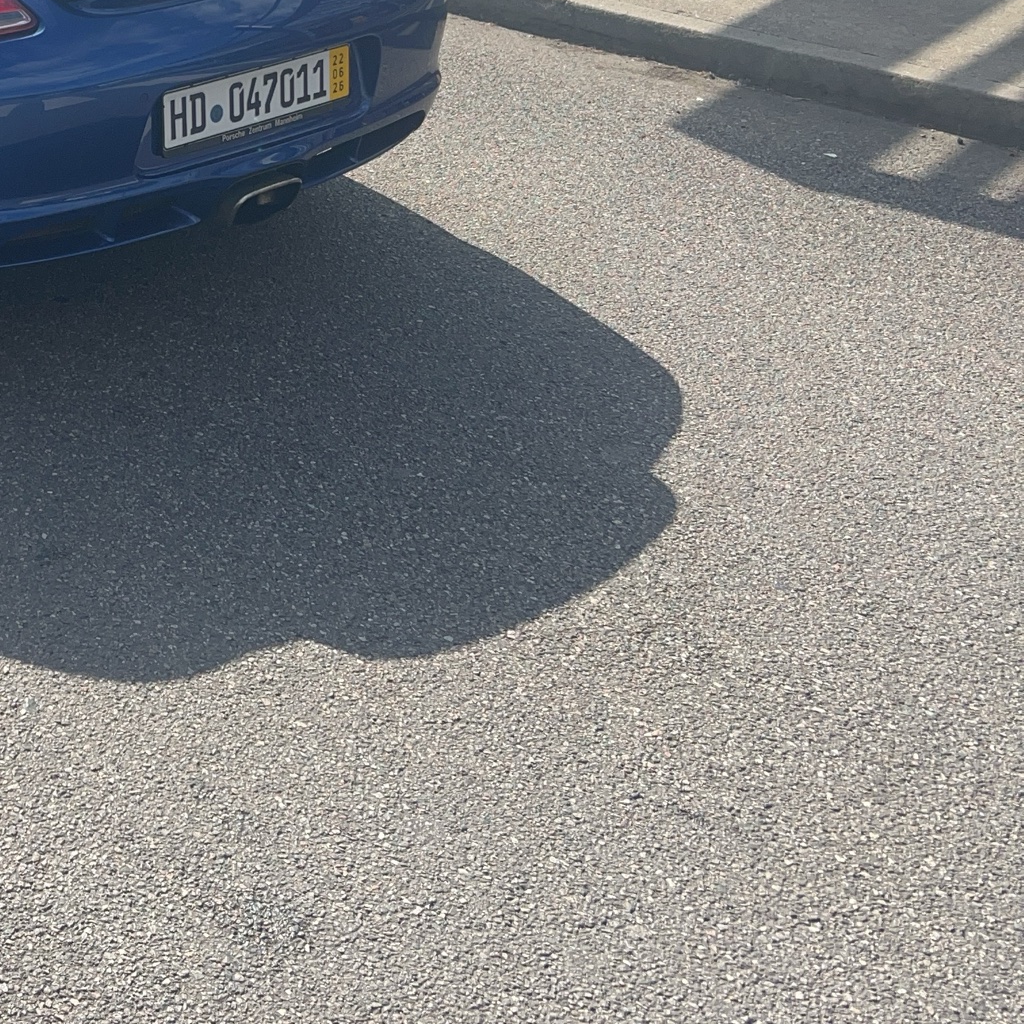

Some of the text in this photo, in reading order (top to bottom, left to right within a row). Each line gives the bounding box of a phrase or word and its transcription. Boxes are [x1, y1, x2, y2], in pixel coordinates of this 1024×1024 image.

[332, 53, 344, 66] 22
[332, 66, 344, 79] 06
[332, 80, 344, 93] 26
[170, 59, 327, 141] HD 047011
[221, 113, 304, 142] Porsche Zentrum Mannheim
